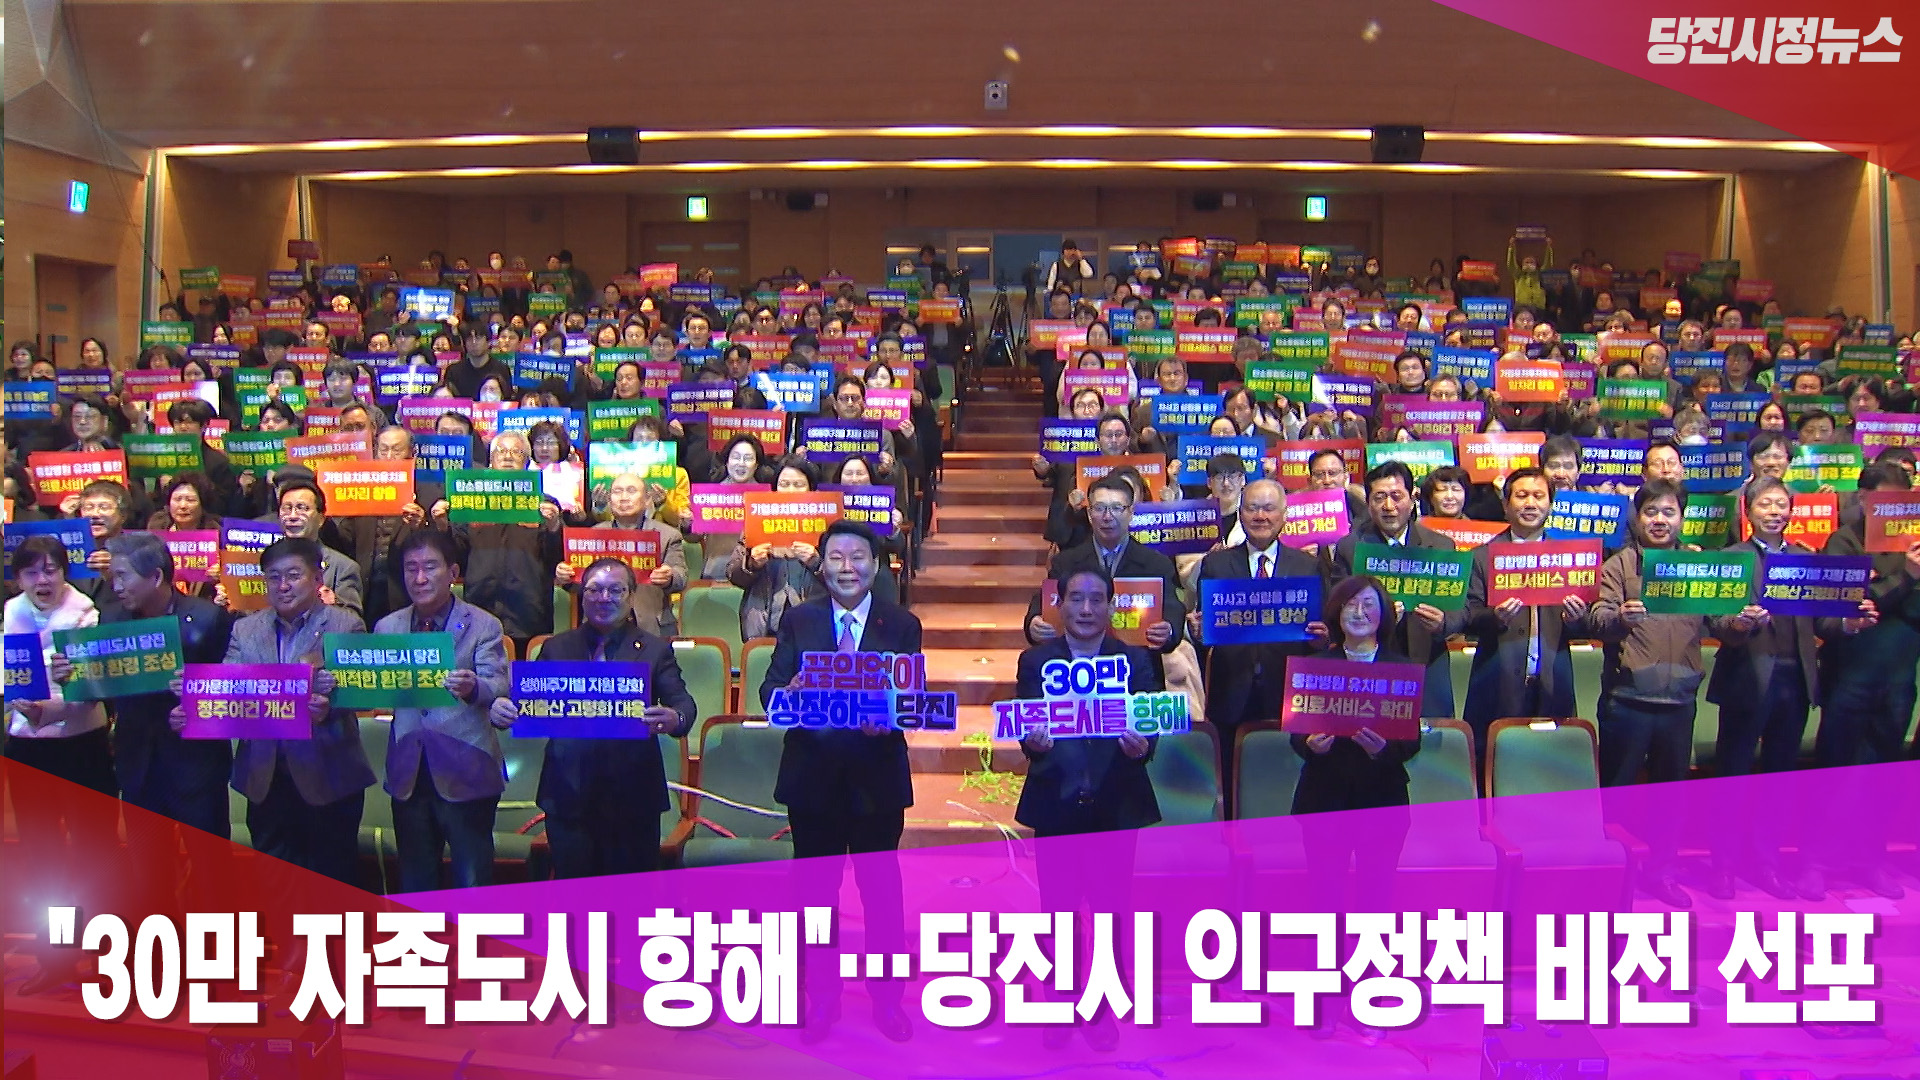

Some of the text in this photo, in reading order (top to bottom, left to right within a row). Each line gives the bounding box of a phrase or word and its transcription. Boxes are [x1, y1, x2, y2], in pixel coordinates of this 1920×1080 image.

[1582, 447, 1609, 459] 주기별
[1476, 457, 1508, 468] 일자리
[335, 486, 397, 501] 일자리 창출
[514, 480, 533, 492] 당진
[450, 495, 540, 510] 쾌적한 환경 조성
[693, 494, 744, 505] 여가문화생활
[751, 503, 837, 516] 기업유치투자유치로
[1552, 501, 1620, 517] 사고 설립을 통한
[1791, 506, 1811, 516] 치를
[762, 519, 826, 533] 일자리 창출
[1313, 516, 1337, 532] 개선
[1579, 519, 1590, 532] 질
[1594, 520, 1617, 534] 향상
[1807, 521, 1831, 533] 확대
[1366, 557, 1460, 577] 탄소중립도시 당진
[1494, 552, 1597, 569] 종합병원 유치를 통한
[1655, 563, 1743, 578] 탄소중립도시 당진
[1768, 566, 1821, 582] 생애주기별
[239, 580, 267, 594] 일자
[1403, 578, 1432, 595] 환경
[1434, 580, 1463, 596] 조성
[1494, 571, 1596, 590] 의료서비스 확대
[1646, 581, 1746, 597] 쾌적한 환경 조성
[1764, 584, 1800, 599] 저출산
[1802, 585, 1837, 600] 고령화
[1212, 590, 1308, 606] 자사고 설립을 통한
[1214, 607, 1308, 626] 교육의 질 향상
[64, 632, 165, 658] 탄소중립도시 당진
[336, 648, 440, 664] 탄소중립도시 당진
[107, 655, 140, 678] 환경
[144, 651, 176, 672] 조성
[803, 652, 925, 690] 끊임없이
[334, 669, 448, 688] 쾌적한 환경 조성
[1043, 657, 1129, 695] 30만
[186, 678, 308, 696] 여가문화생활공간 확충
[519, 677, 644, 694] 생애주기별 지원 강화
[1291, 673, 1417, 696] 종합병원 유치를 통한
[197, 700, 296, 719] 정주여건 개선
[518, 699, 645, 717] 저출산 고령화 대응
[770, 692, 957, 729] 성장하는 당진
[1290, 695, 1413, 719] 의료서비스 확대
[995, 695, 1188, 738] 자족도시를 향해
